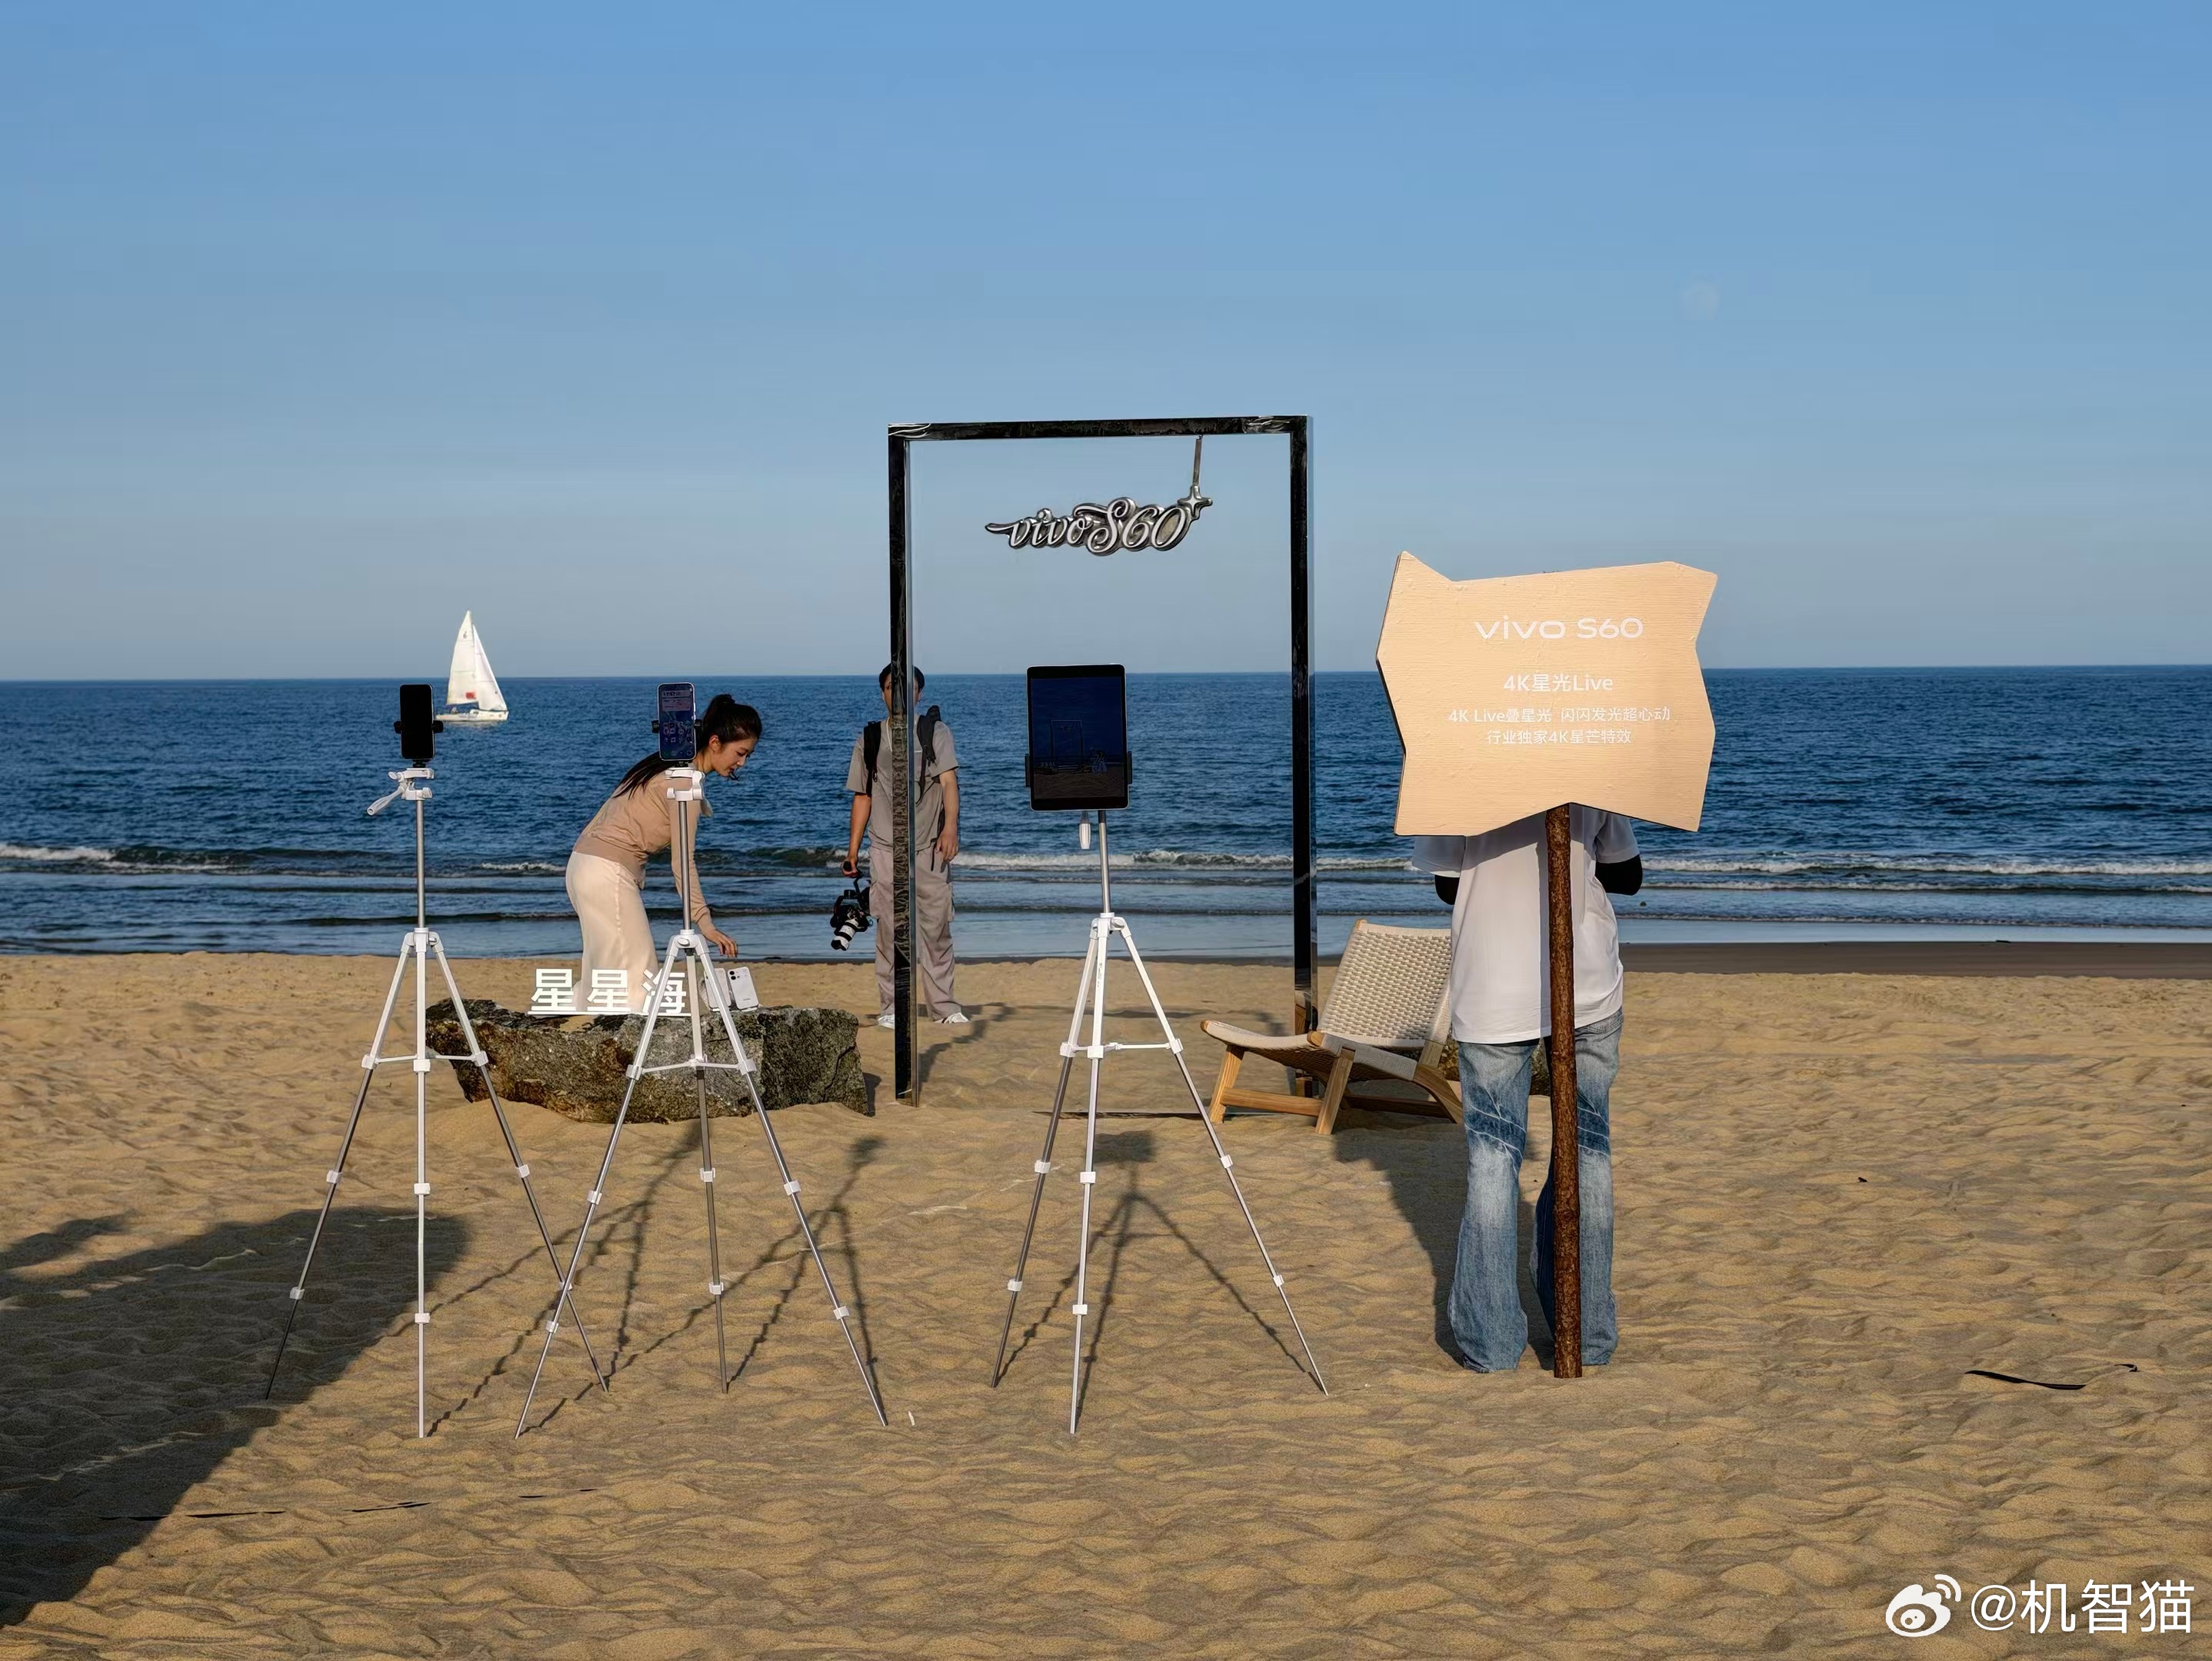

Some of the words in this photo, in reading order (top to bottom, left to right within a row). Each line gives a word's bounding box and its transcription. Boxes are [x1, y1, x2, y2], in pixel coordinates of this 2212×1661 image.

[1475, 614, 1566, 640] vivo
[1577, 617, 1644, 639] S60
[1503, 673, 1613, 692] 4K星光Live
[1561, 706, 1671, 722] 闪闪发光超心动
[1484, 729, 1631, 745] 行业独家4K星芒特效
[531, 968, 687, 1014] 星星海
